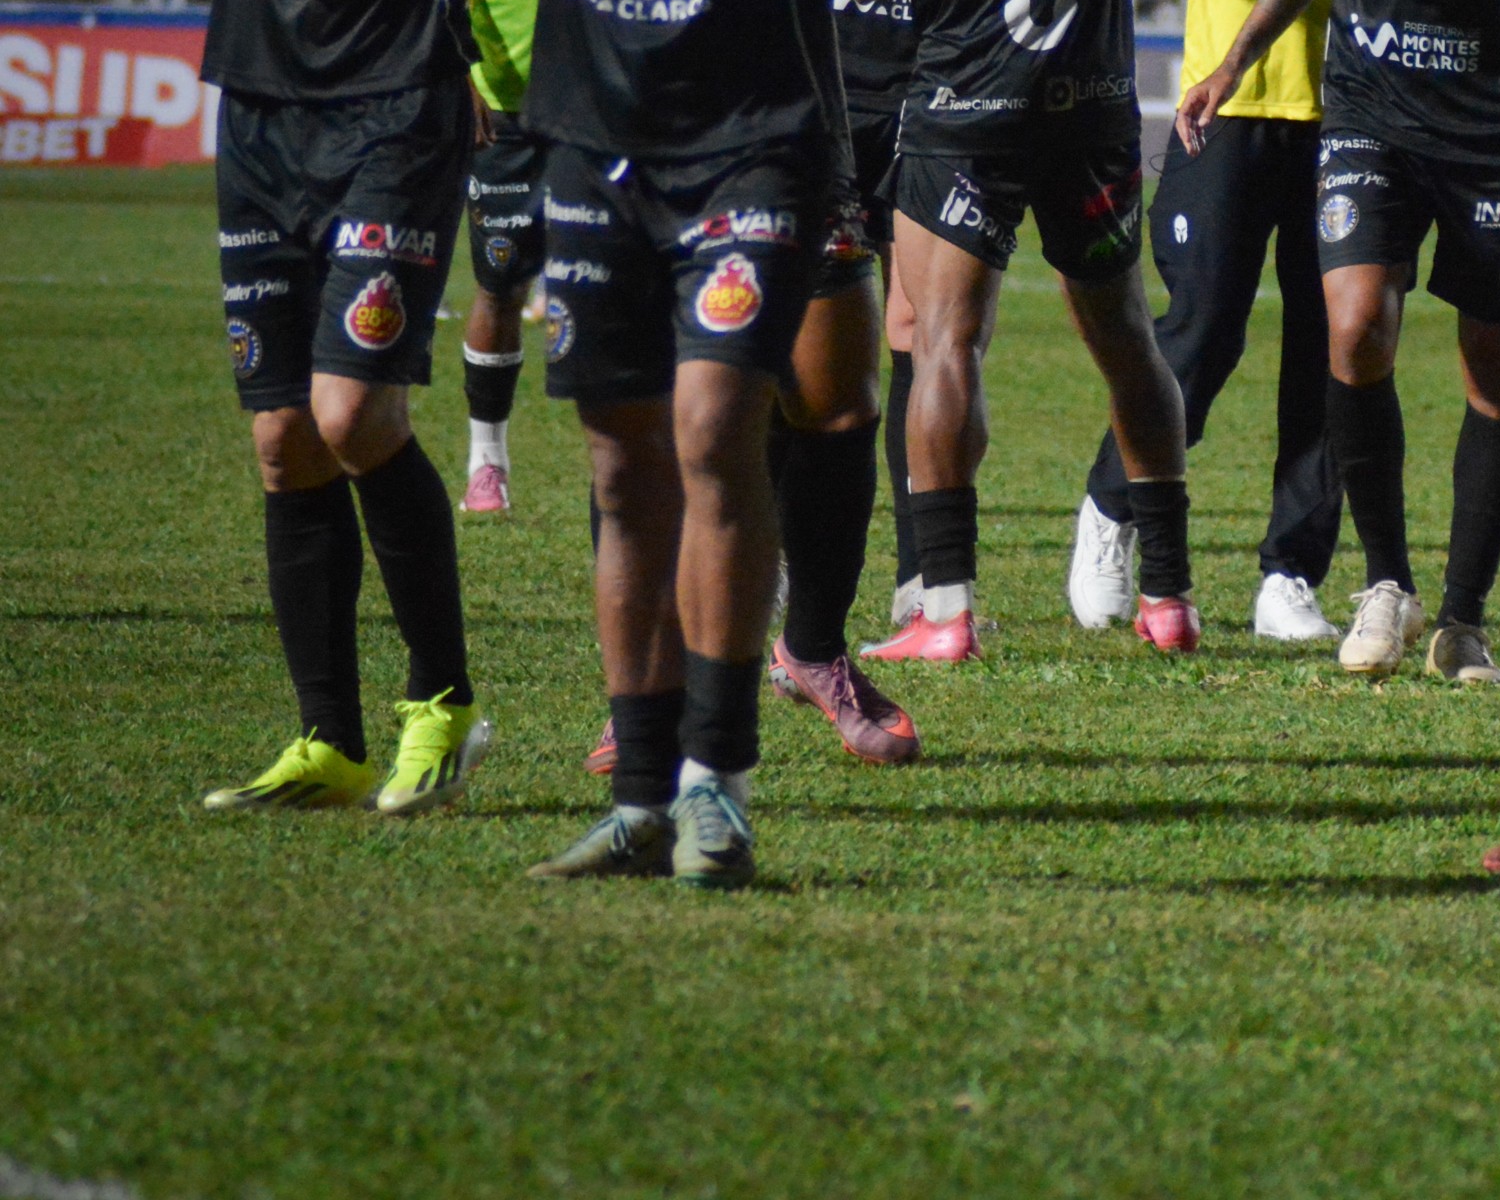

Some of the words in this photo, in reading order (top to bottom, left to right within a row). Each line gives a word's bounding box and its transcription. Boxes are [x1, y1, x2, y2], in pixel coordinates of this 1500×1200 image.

[1402, 33, 1481, 56] MONTES
[1402, 52, 1478, 73] CLAROS
[2, 119, 118, 161] BET
